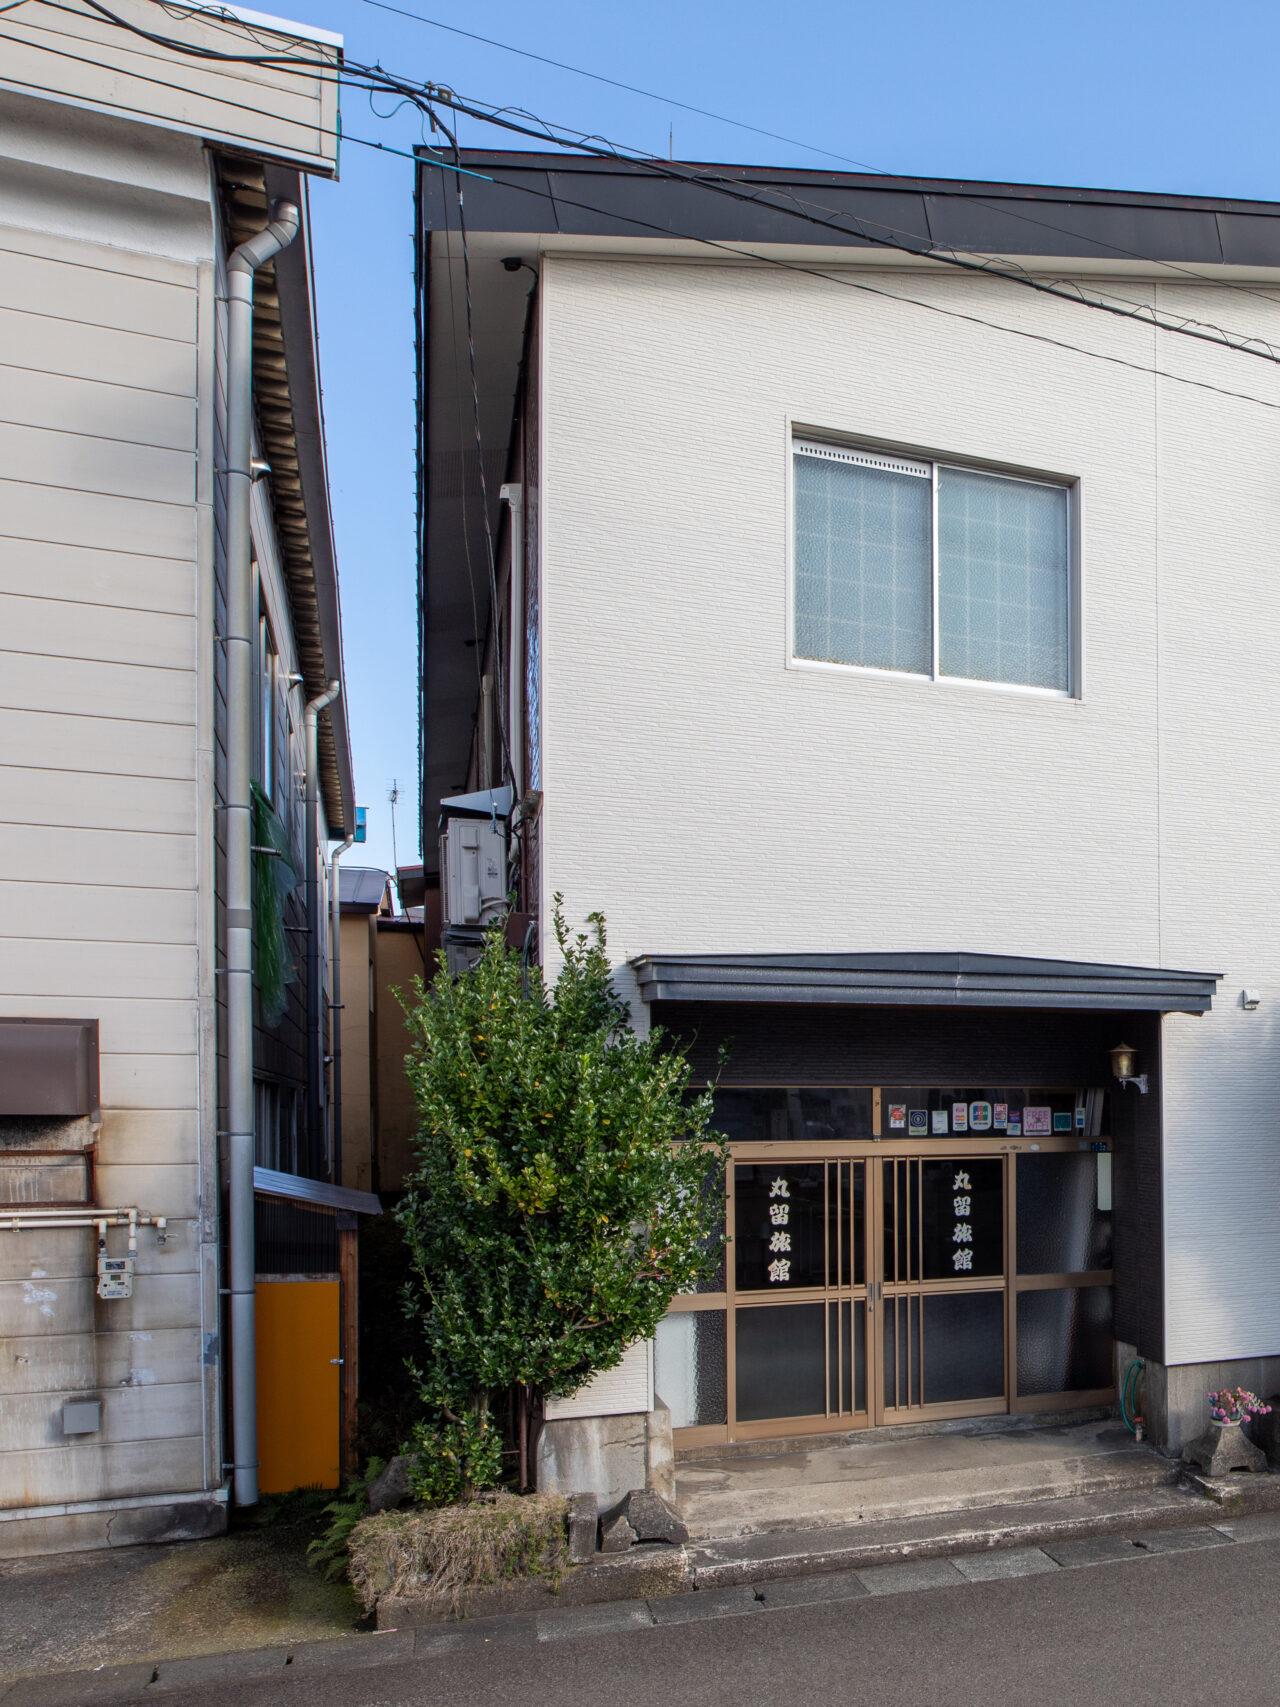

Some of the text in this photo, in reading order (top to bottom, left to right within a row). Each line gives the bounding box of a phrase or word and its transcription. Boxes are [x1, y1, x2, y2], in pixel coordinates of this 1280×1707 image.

[1026, 1110, 1049, 1120] FREE
[768, 1176, 791, 1282] 丸留旅館
[952, 1169, 973, 1271] 丸留旅館
